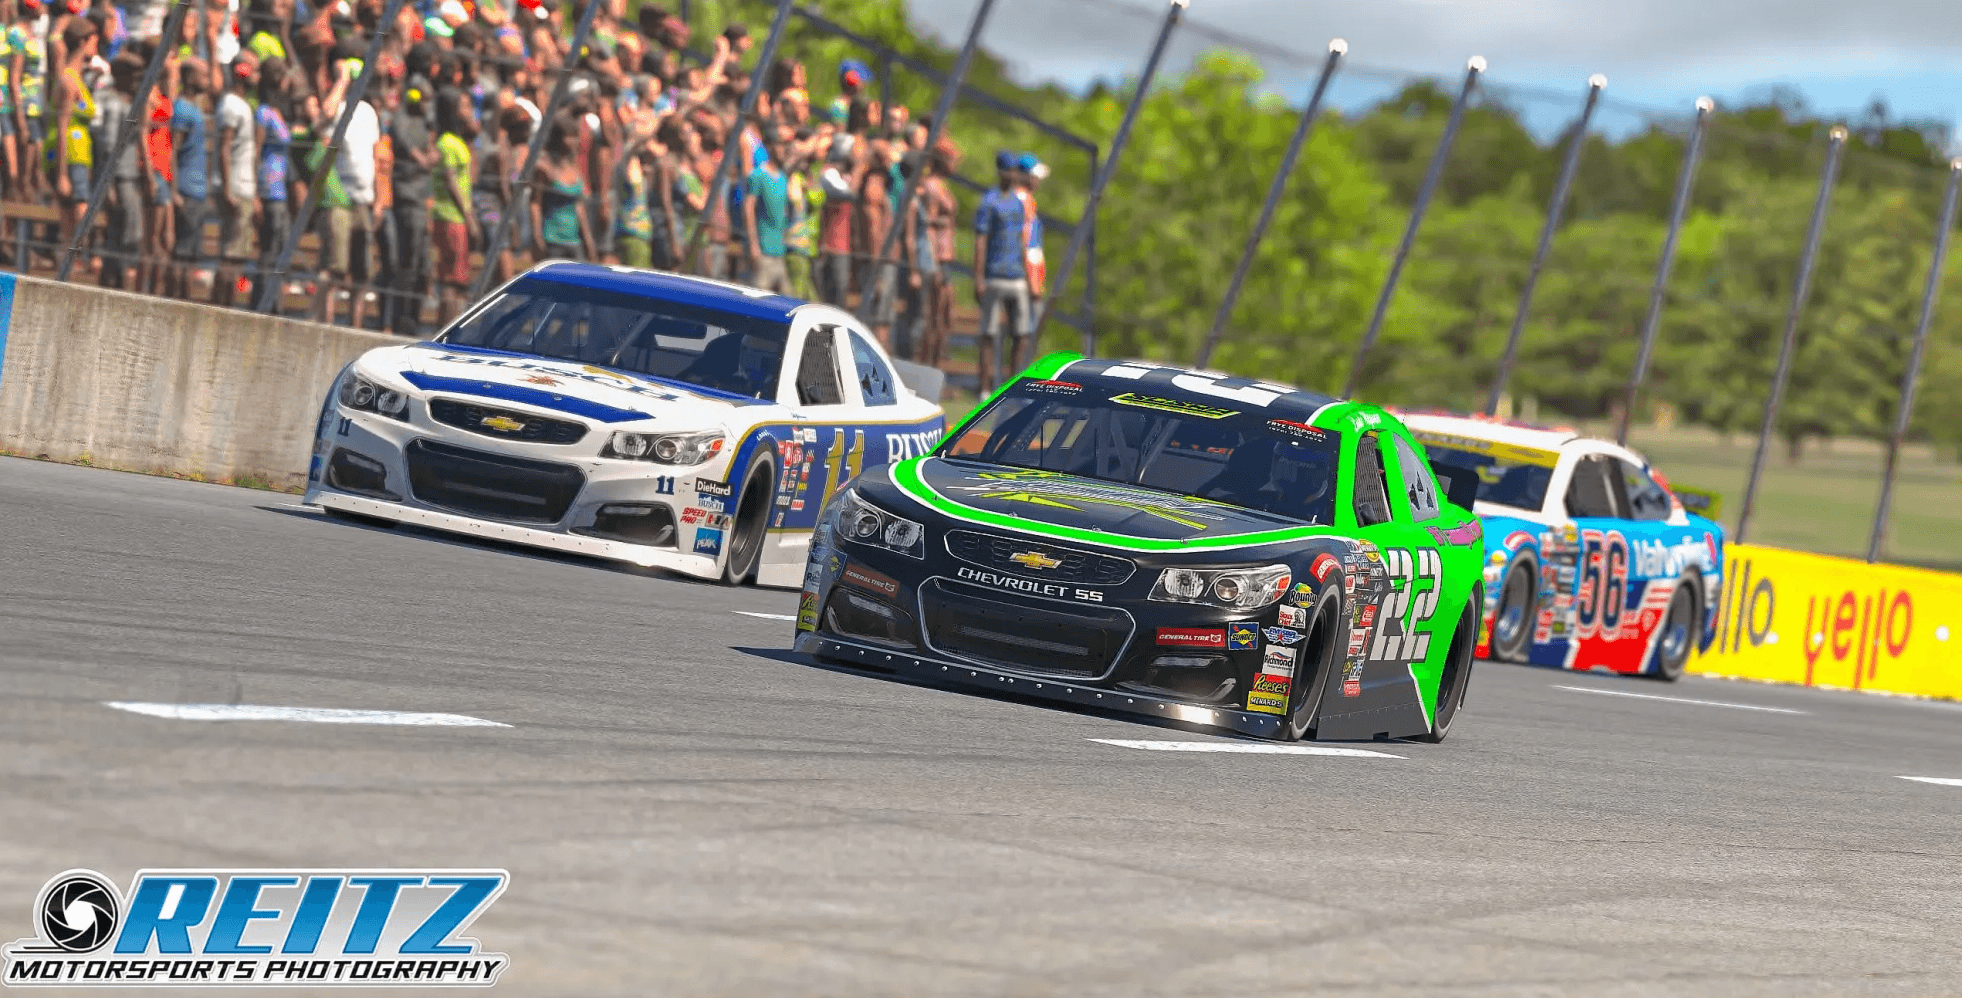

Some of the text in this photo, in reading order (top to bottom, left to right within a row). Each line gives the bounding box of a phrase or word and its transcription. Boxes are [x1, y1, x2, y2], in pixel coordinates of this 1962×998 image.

[337, 416, 353, 437] 11
[655, 475, 675, 495] 11
[814, 427, 865, 520] 11
[697, 480, 731, 496] DieHard
[682, 507, 707, 518] SPEED
[957, 567, 1104, 602] CHEVROLET SS
[1576, 529, 1628, 641] 56
[1369, 546, 1443, 662] 22
[1718, 558, 1775, 654] llo
[1159, 633, 1193, 641] GENERAL
[1802, 588, 1914, 689] yello
[1264, 654, 1294, 668] Richmond
